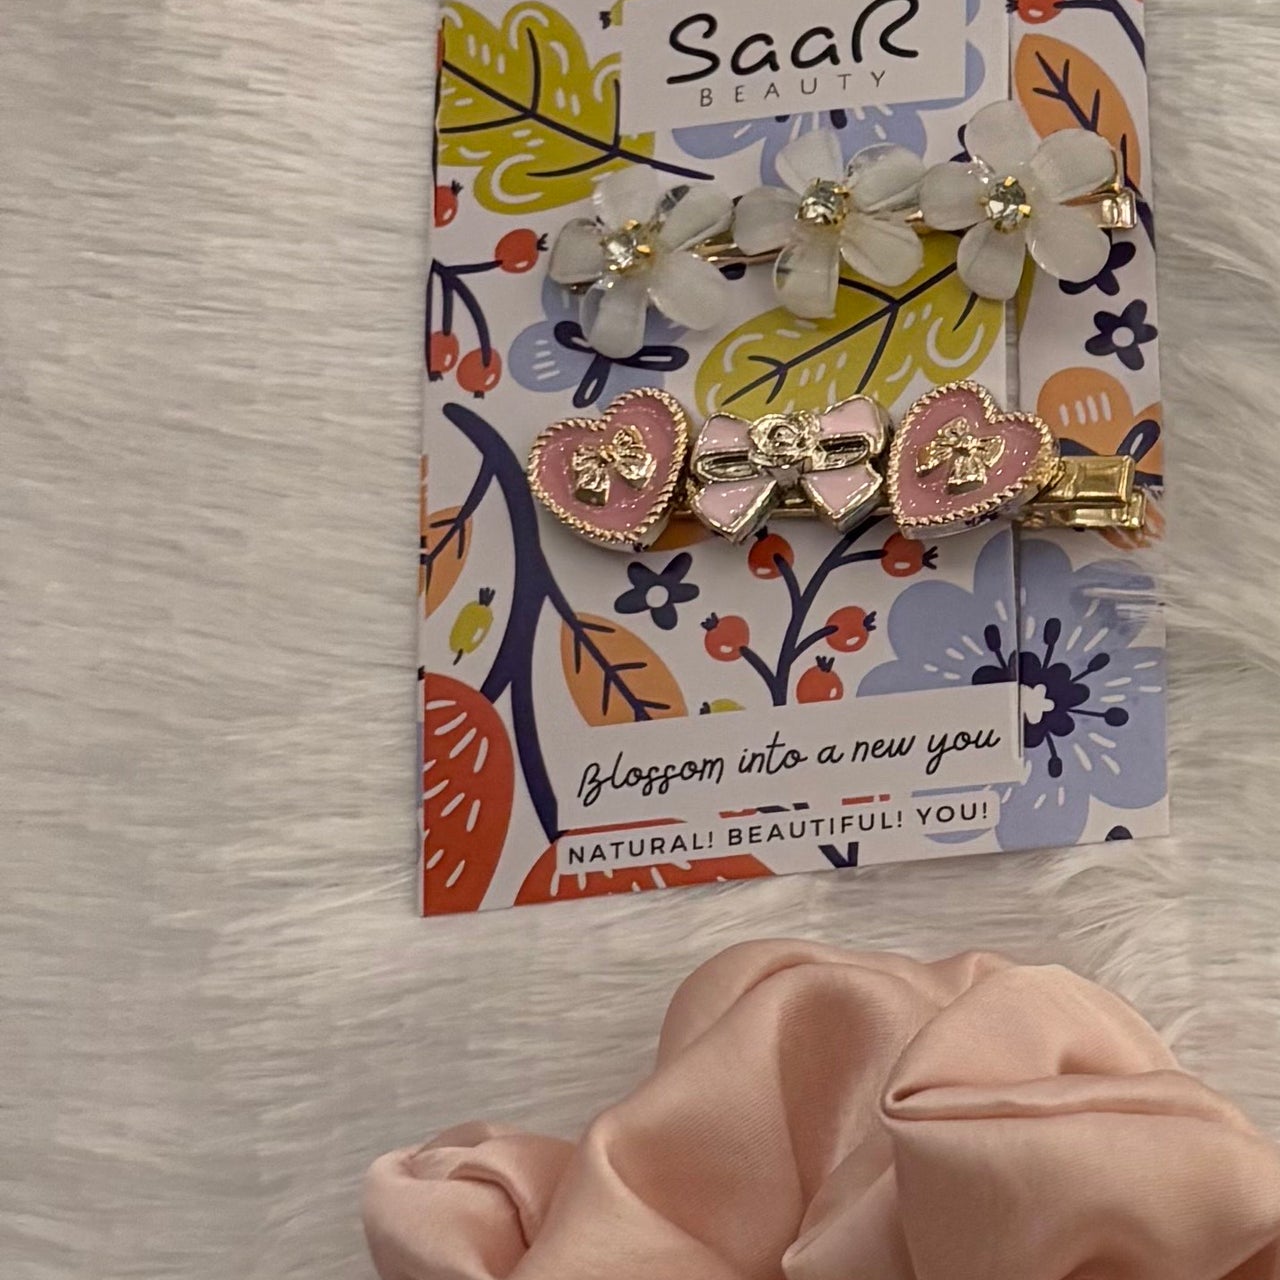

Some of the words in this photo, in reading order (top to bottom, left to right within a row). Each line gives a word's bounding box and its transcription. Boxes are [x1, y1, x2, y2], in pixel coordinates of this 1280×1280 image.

[700, 71, 885, 107] BEAUTY
[577, 751, 725, 807] Blossom
[737, 731, 808, 775] into
[817, 747, 845, 764] a
[851, 736, 916, 763] new
[927, 727, 1001, 774] you
[569, 831, 714, 865] NATURAL!
[728, 811, 902, 846] BEAUTIFUL!
[916, 802, 988, 825] YOU!
